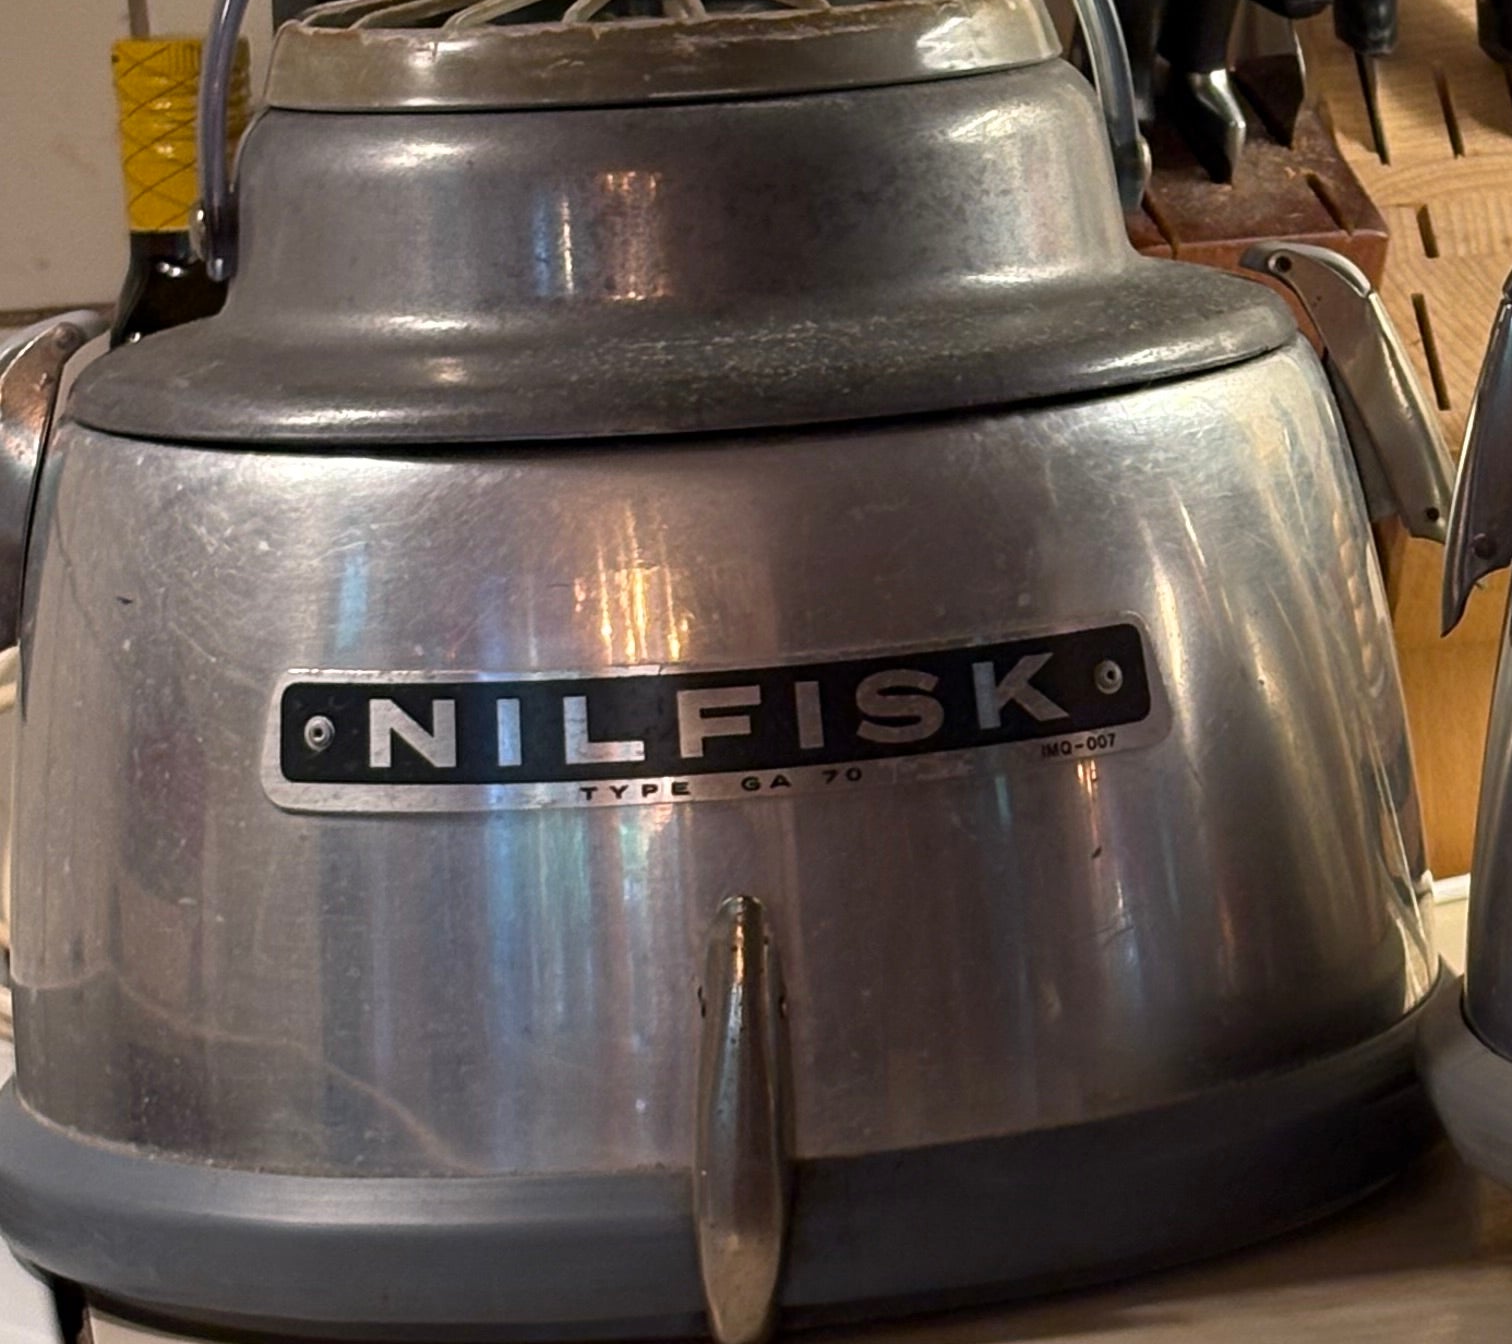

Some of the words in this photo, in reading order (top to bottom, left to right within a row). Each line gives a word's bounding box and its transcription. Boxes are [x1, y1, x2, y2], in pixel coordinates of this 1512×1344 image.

[369, 652, 1070, 768] NILFISK
[579, 781, 692, 802] TYPE
[740, 773, 793, 792] GA
[821, 767, 863, 785] 70
